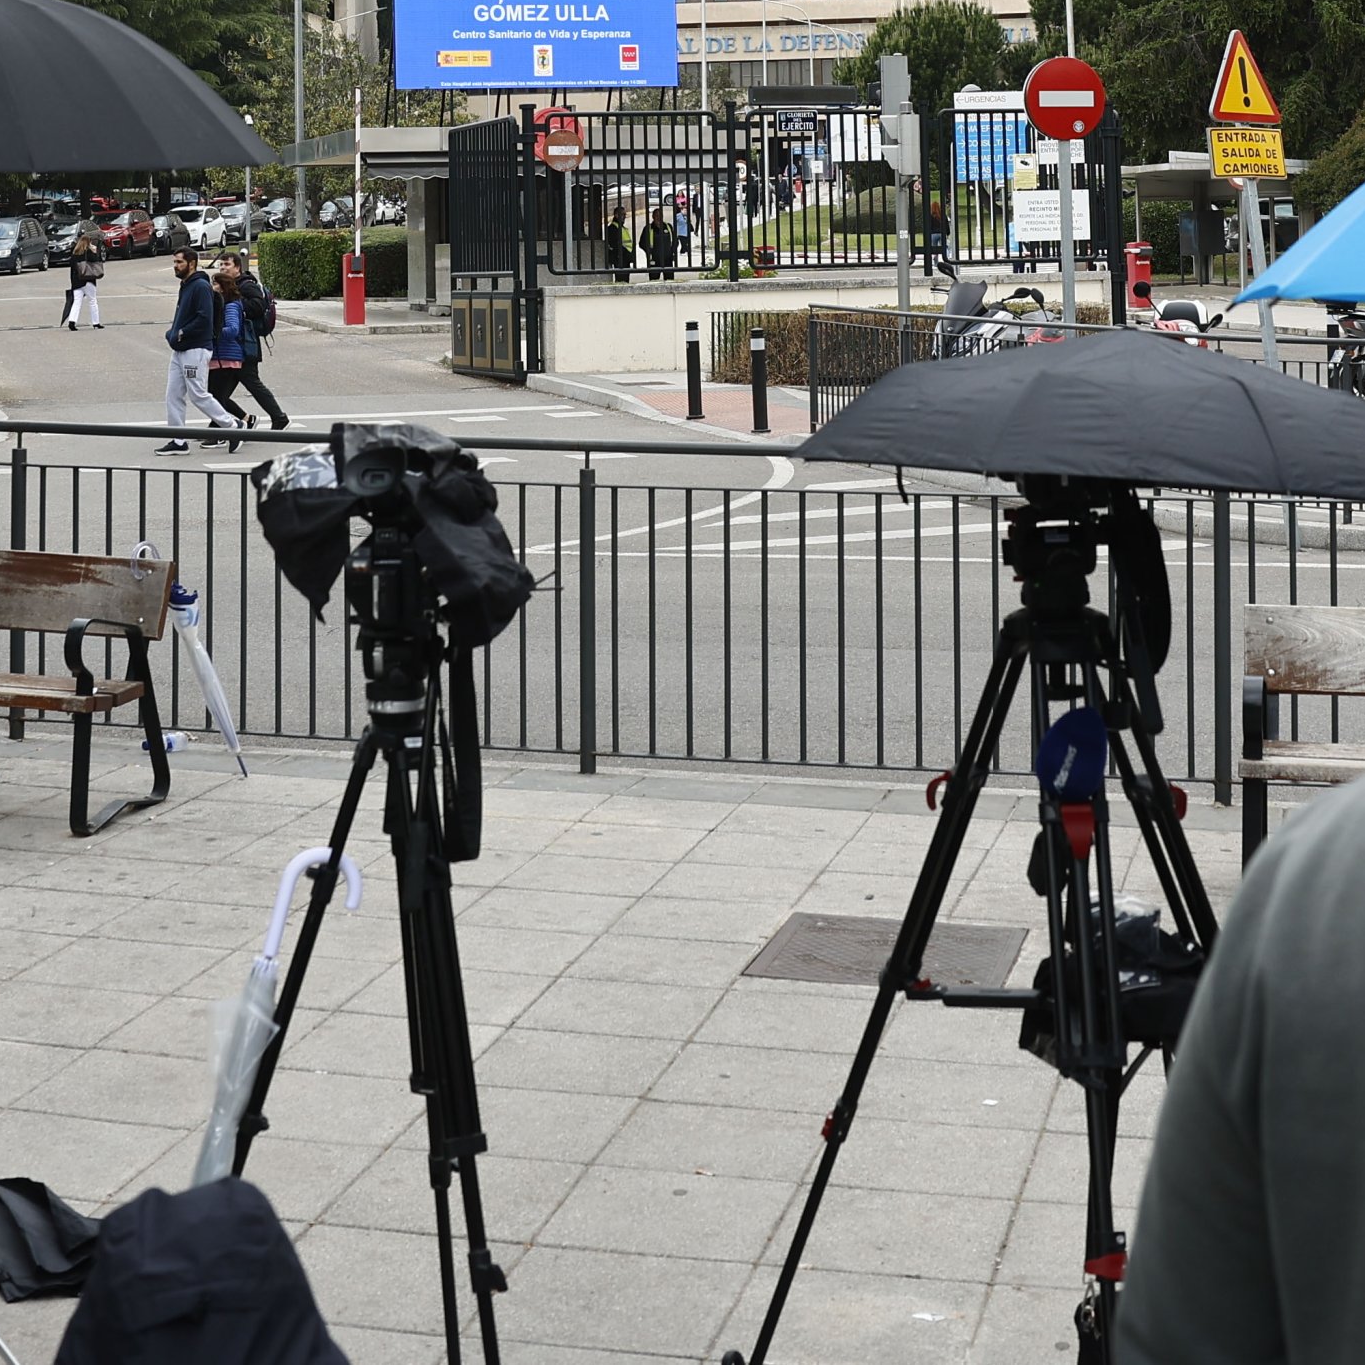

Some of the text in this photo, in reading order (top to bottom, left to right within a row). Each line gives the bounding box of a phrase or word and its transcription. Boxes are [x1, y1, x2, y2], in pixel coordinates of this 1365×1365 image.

[473, 0, 610, 22] GÓMEZ ULLA
[452, 29, 631, 41] Centro Sanitario de Vida y Esperanza
[705, 37, 737, 54] DE
[742, 36, 772, 53] LA
[780, 32, 865, 52] DEFENS
[964, 95, 1007, 103] URGENCIAS
[968, 124, 1013, 133] MAERNIDAD
[968, 138, 1011, 147] COSULTAS
[1217, 132, 1277, 144] ENTRADA Y
[1221, 147, 1278, 159] SALIDA DE
[1223, 163, 1280, 174] CAMIONES
